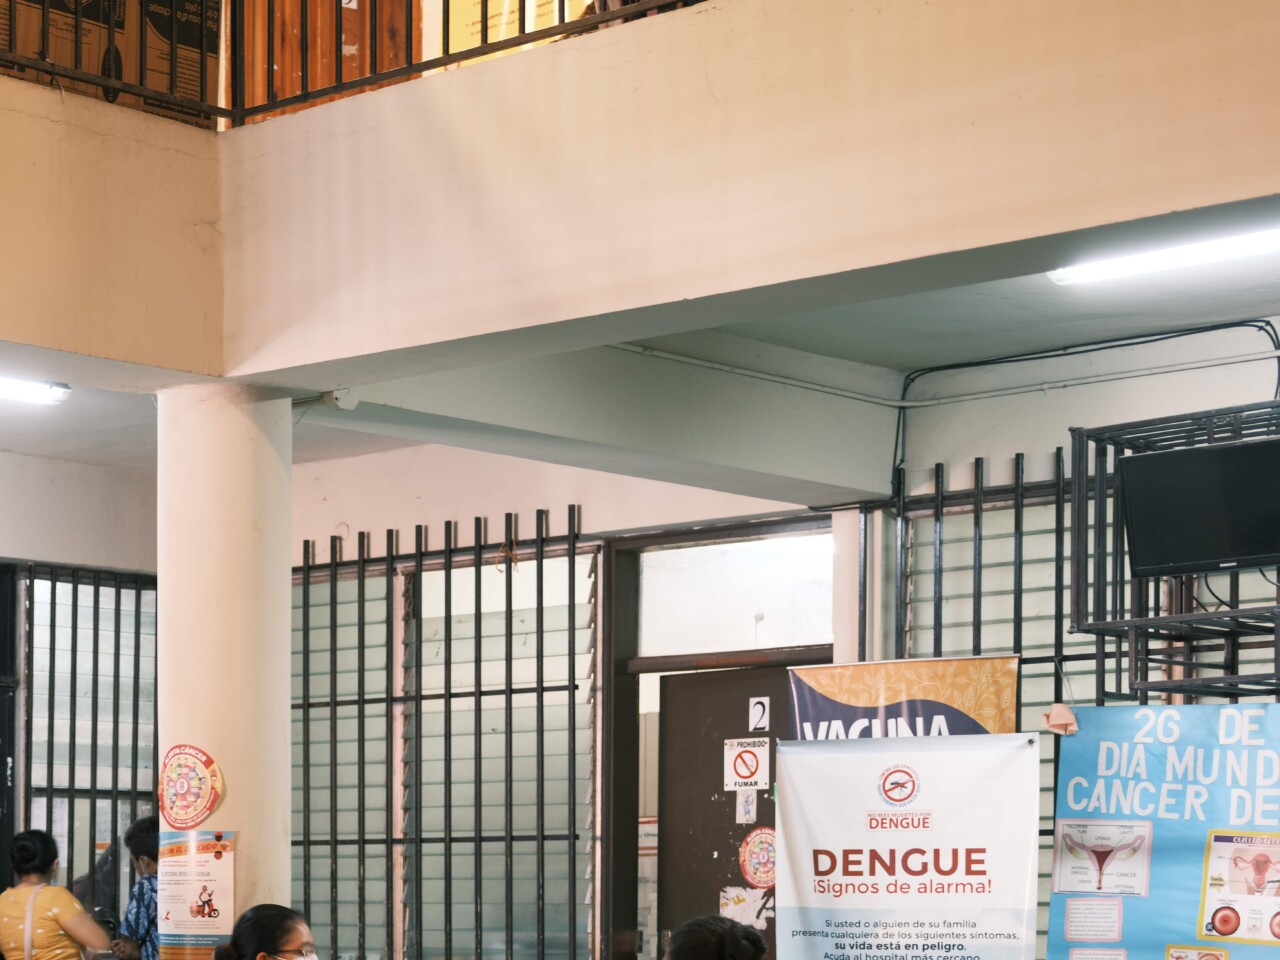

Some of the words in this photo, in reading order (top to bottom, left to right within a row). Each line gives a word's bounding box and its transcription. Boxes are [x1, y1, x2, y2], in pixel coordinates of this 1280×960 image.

[752, 700, 767, 731] 2
[1133, 708, 1181, 744] 26
[1218, 708, 1265, 746] DE
[736, 740, 766, 748] PROHIBIDO
[180, 746, 207, 762] CÁNCER
[1097, 741, 1147, 779] DIA
[1067, 776, 1208, 821] CANCER
[869, 817, 930, 829] DENGUE
[812, 848, 986, 876] DENGUE
[813, 880, 879, 897] ¡Signos
[886, 879, 911, 894] de
[917, 879, 991, 894] alarma!
[825, 919, 833, 928] Si
[834, 920, 861, 928] usted
[873, 920, 909, 930] alguien
[913, 920, 926, 929] de
[942, 920, 977, 929] familia
[792, 929, 829, 939] presenta
[830, 930, 879, 940] cualquiera
[882, 930, 895, 939] de
[897, 931, 912, 939] los
[915, 931, 966, 941] siguientes
[849, 941, 873, 950] vida
[876, 941, 901, 951] está
[904, 943, 919, 951] en
[922, 942, 966, 953] peligro.
[824, 952, 851, 960] Acuda
[853, 952, 862, 960] al
